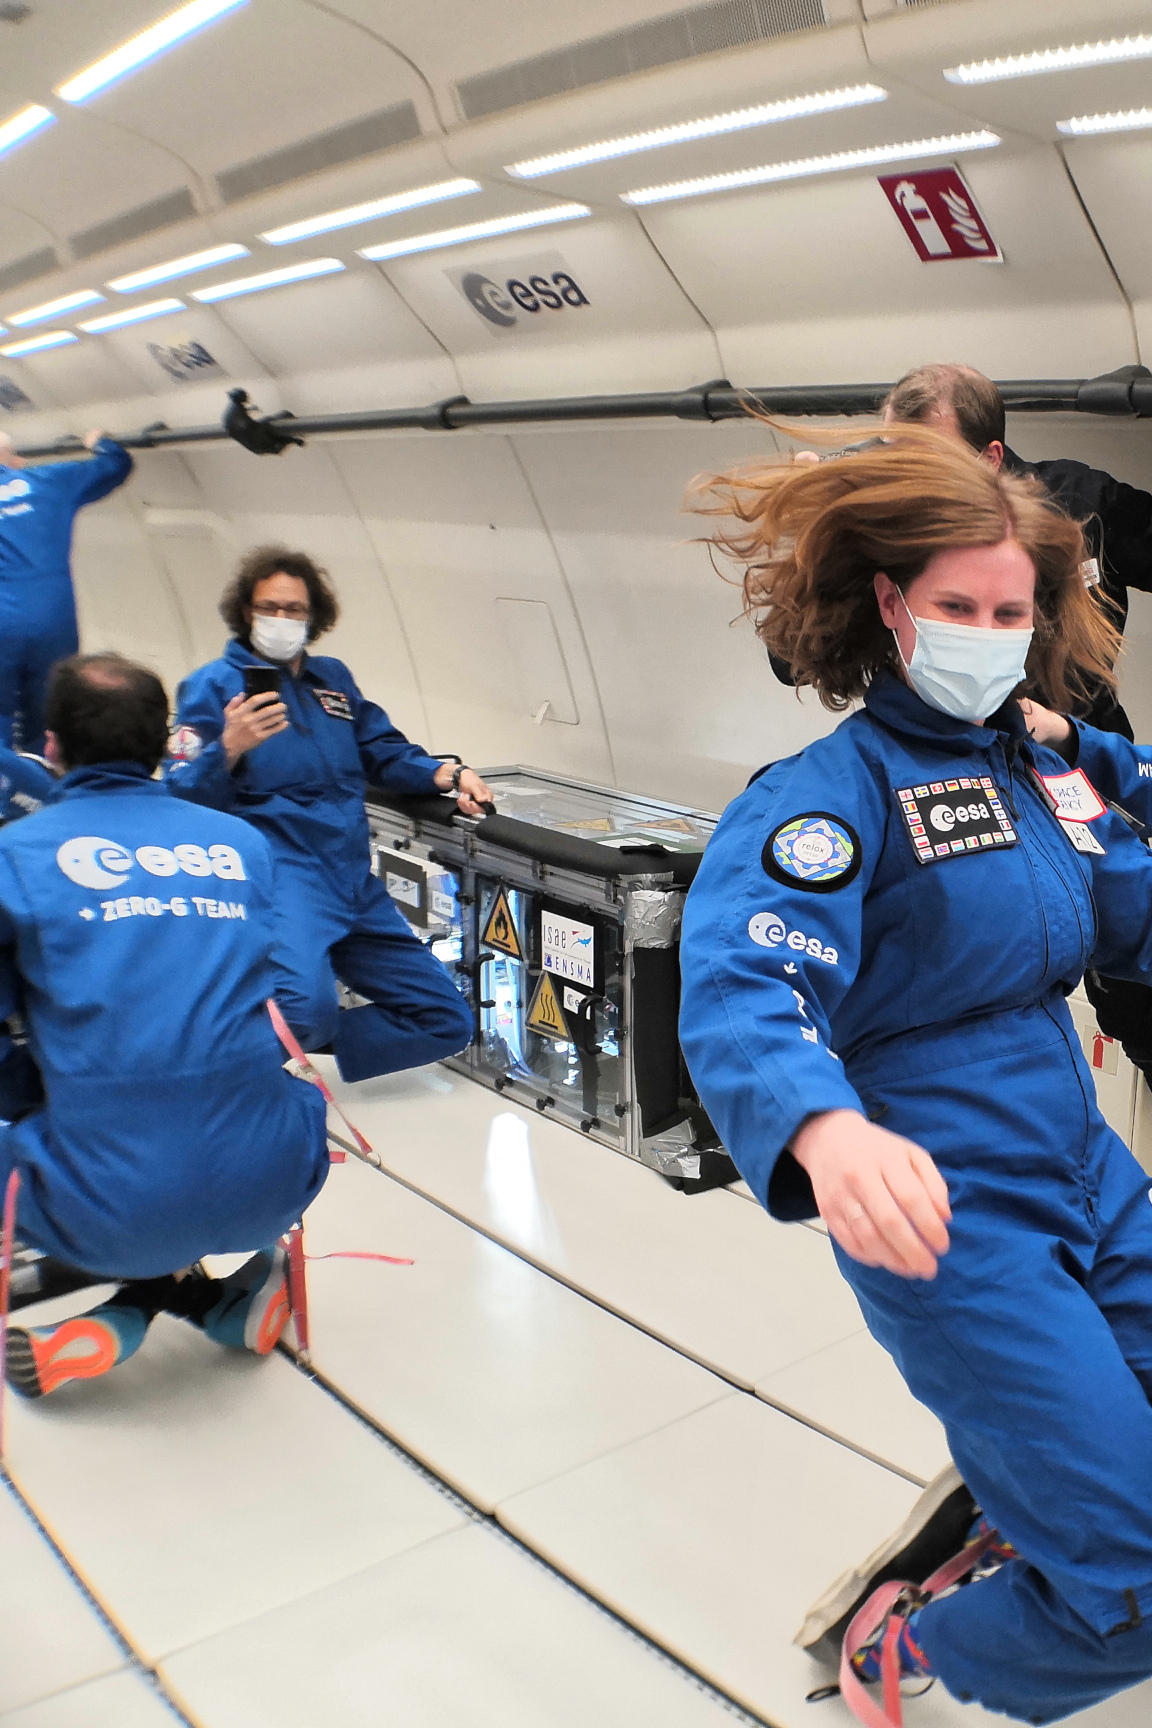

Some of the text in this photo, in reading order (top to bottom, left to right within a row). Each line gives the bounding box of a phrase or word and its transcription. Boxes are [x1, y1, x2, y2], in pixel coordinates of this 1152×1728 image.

[506, 271, 590, 312] esa
[955, 803, 990, 823] esa
[135, 844, 246, 881] esa
[101, 896, 247, 922] ZERO-G TEAM
[786, 930, 838, 965] esa
[555, 956, 591, 982] ENSMA
